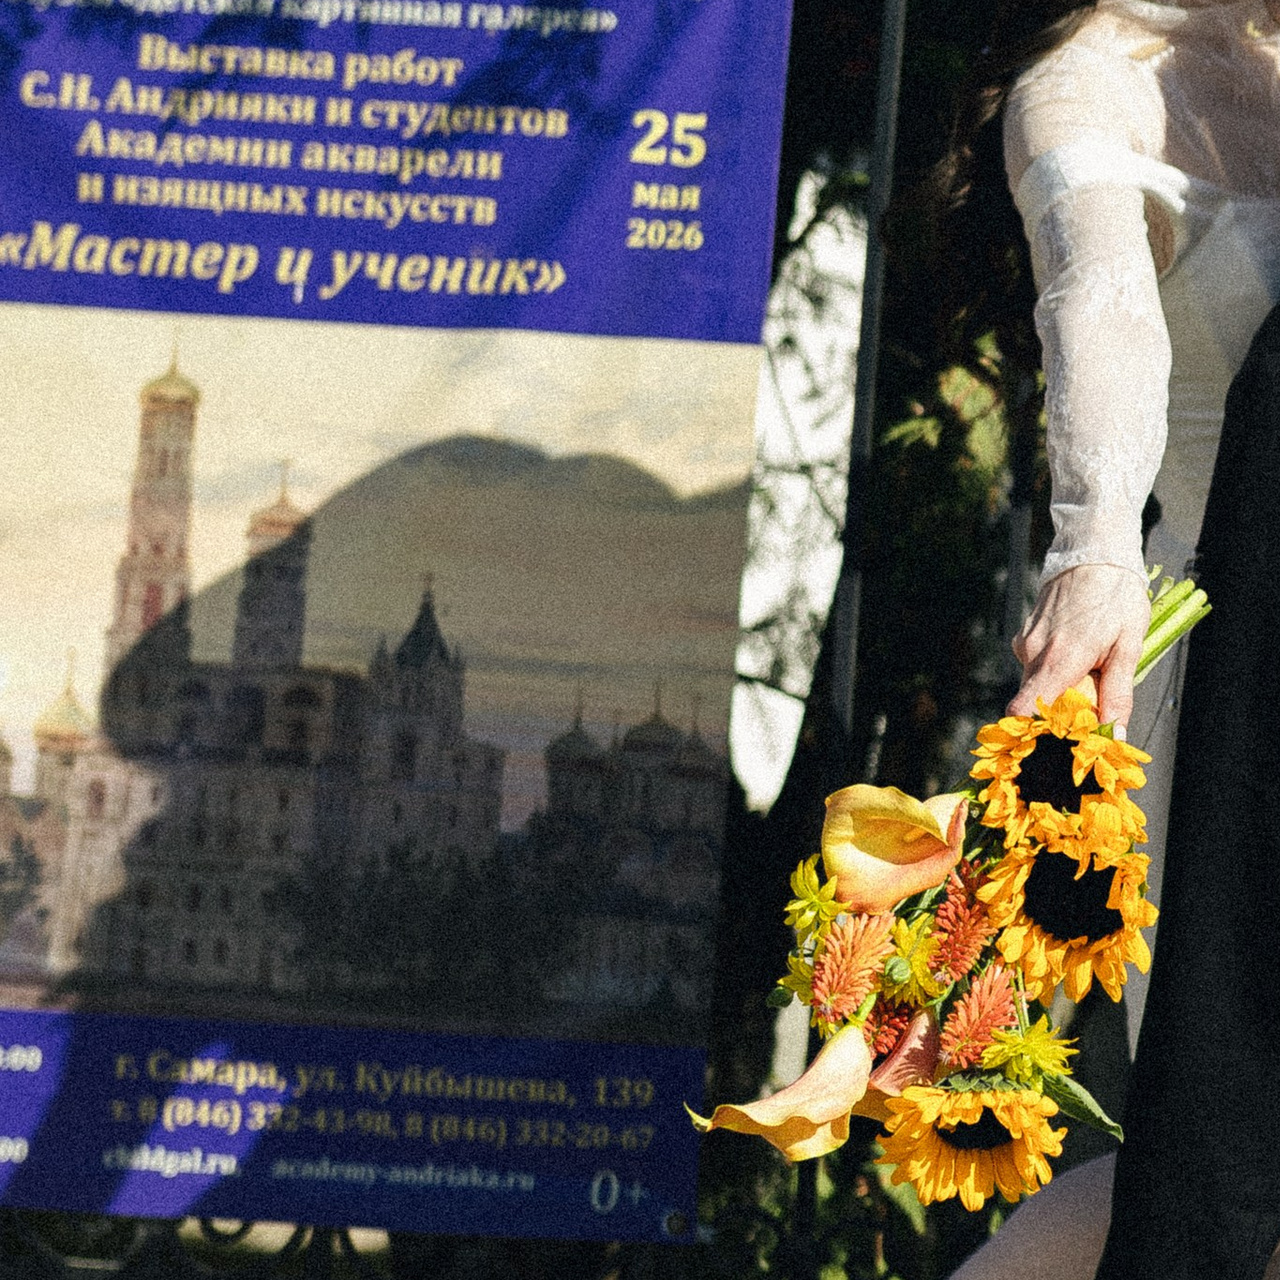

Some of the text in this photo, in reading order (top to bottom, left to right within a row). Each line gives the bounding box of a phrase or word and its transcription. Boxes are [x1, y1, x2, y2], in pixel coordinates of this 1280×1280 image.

[138, 33, 463, 91] Выставка работ
[105, 76, 316, 127] Андрияки
[326, 97, 351, 127] и
[361, 99, 568, 140] студентов
[76, 119, 503, 184] Академии акварели
[630, 108, 708, 168] 25
[77, 173, 497, 229] и изящных искусств
[632, 181, 701, 210] мая
[0, 221, 259, 294] «Мастер
[318, 250, 567, 300] ученик»
[626, 217, 704, 251] 2026
[146, 1048, 287, 1095] Самара,
[293, 1064, 345, 1098] ул.
[353, 1061, 577, 1109] Куйбышева,
[593, 1075, 655, 1108] 139
[161, 1094, 242, 1137] (846)
[589, 1169, 650, 1215] 0+
